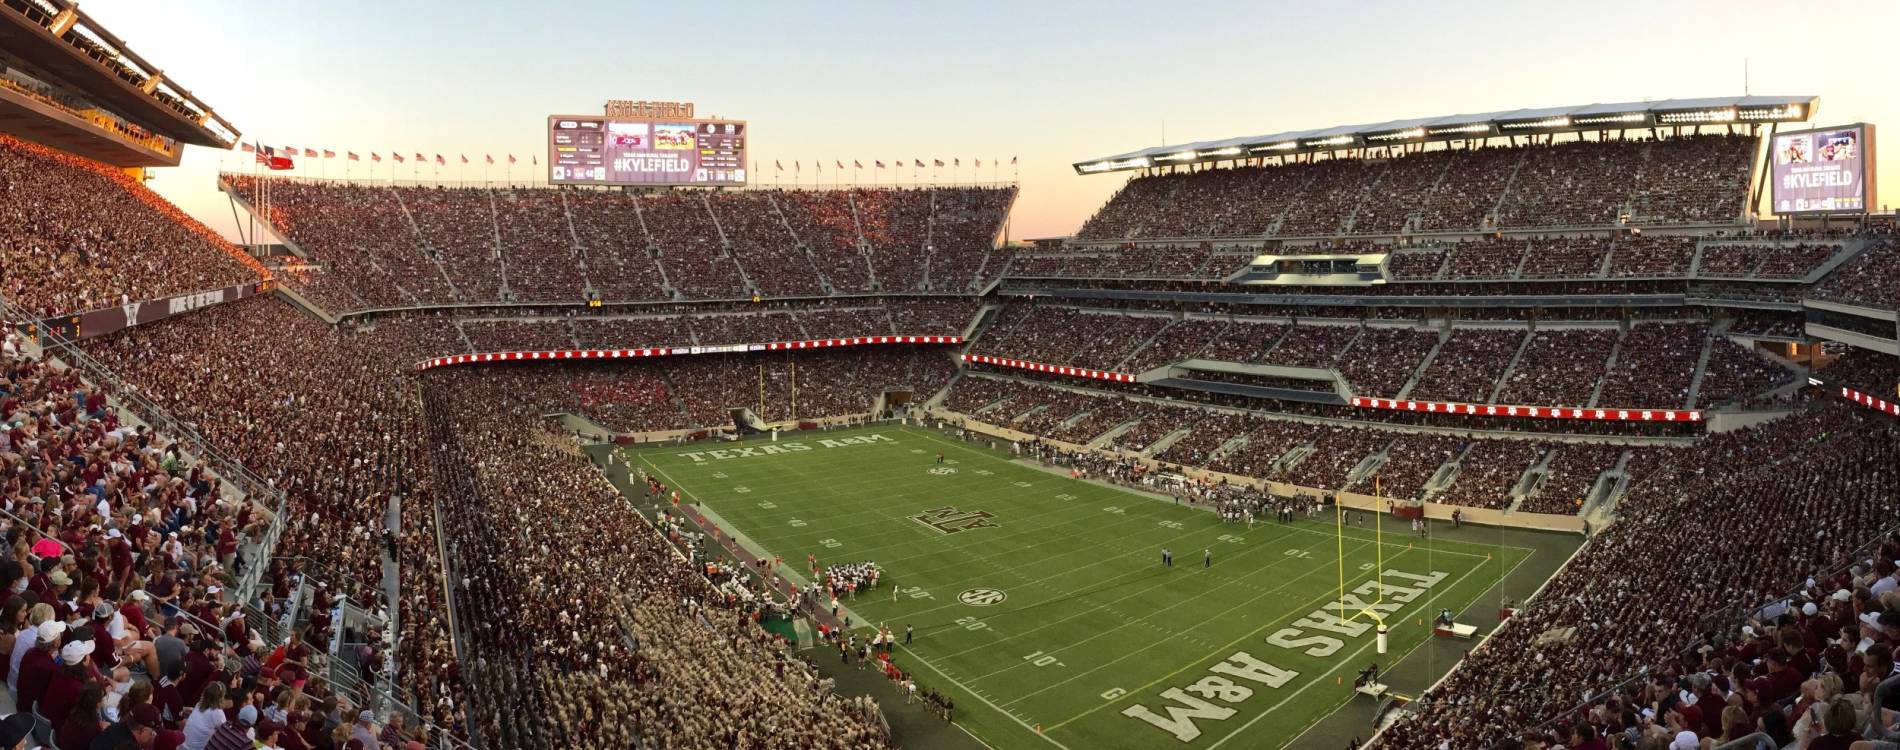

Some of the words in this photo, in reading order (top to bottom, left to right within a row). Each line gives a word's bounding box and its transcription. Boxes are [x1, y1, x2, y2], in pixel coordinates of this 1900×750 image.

[607, 99, 647, 118] KYLE
[652, 101, 694, 118] FIELD
[614, 158, 689, 172] #KYLEFIELD
[1783, 170, 1852, 189] #KYLEFIELD
[680, 442, 813, 462] TEXAS
[816, 434, 894, 449] A&M
[902, 586, 931, 600] 30
[1265, 568, 1450, 657] TEXAS
[955, 616, 987, 631] 20
[1023, 651, 1057, 667] 10
[1121, 651, 1300, 743] A&M
